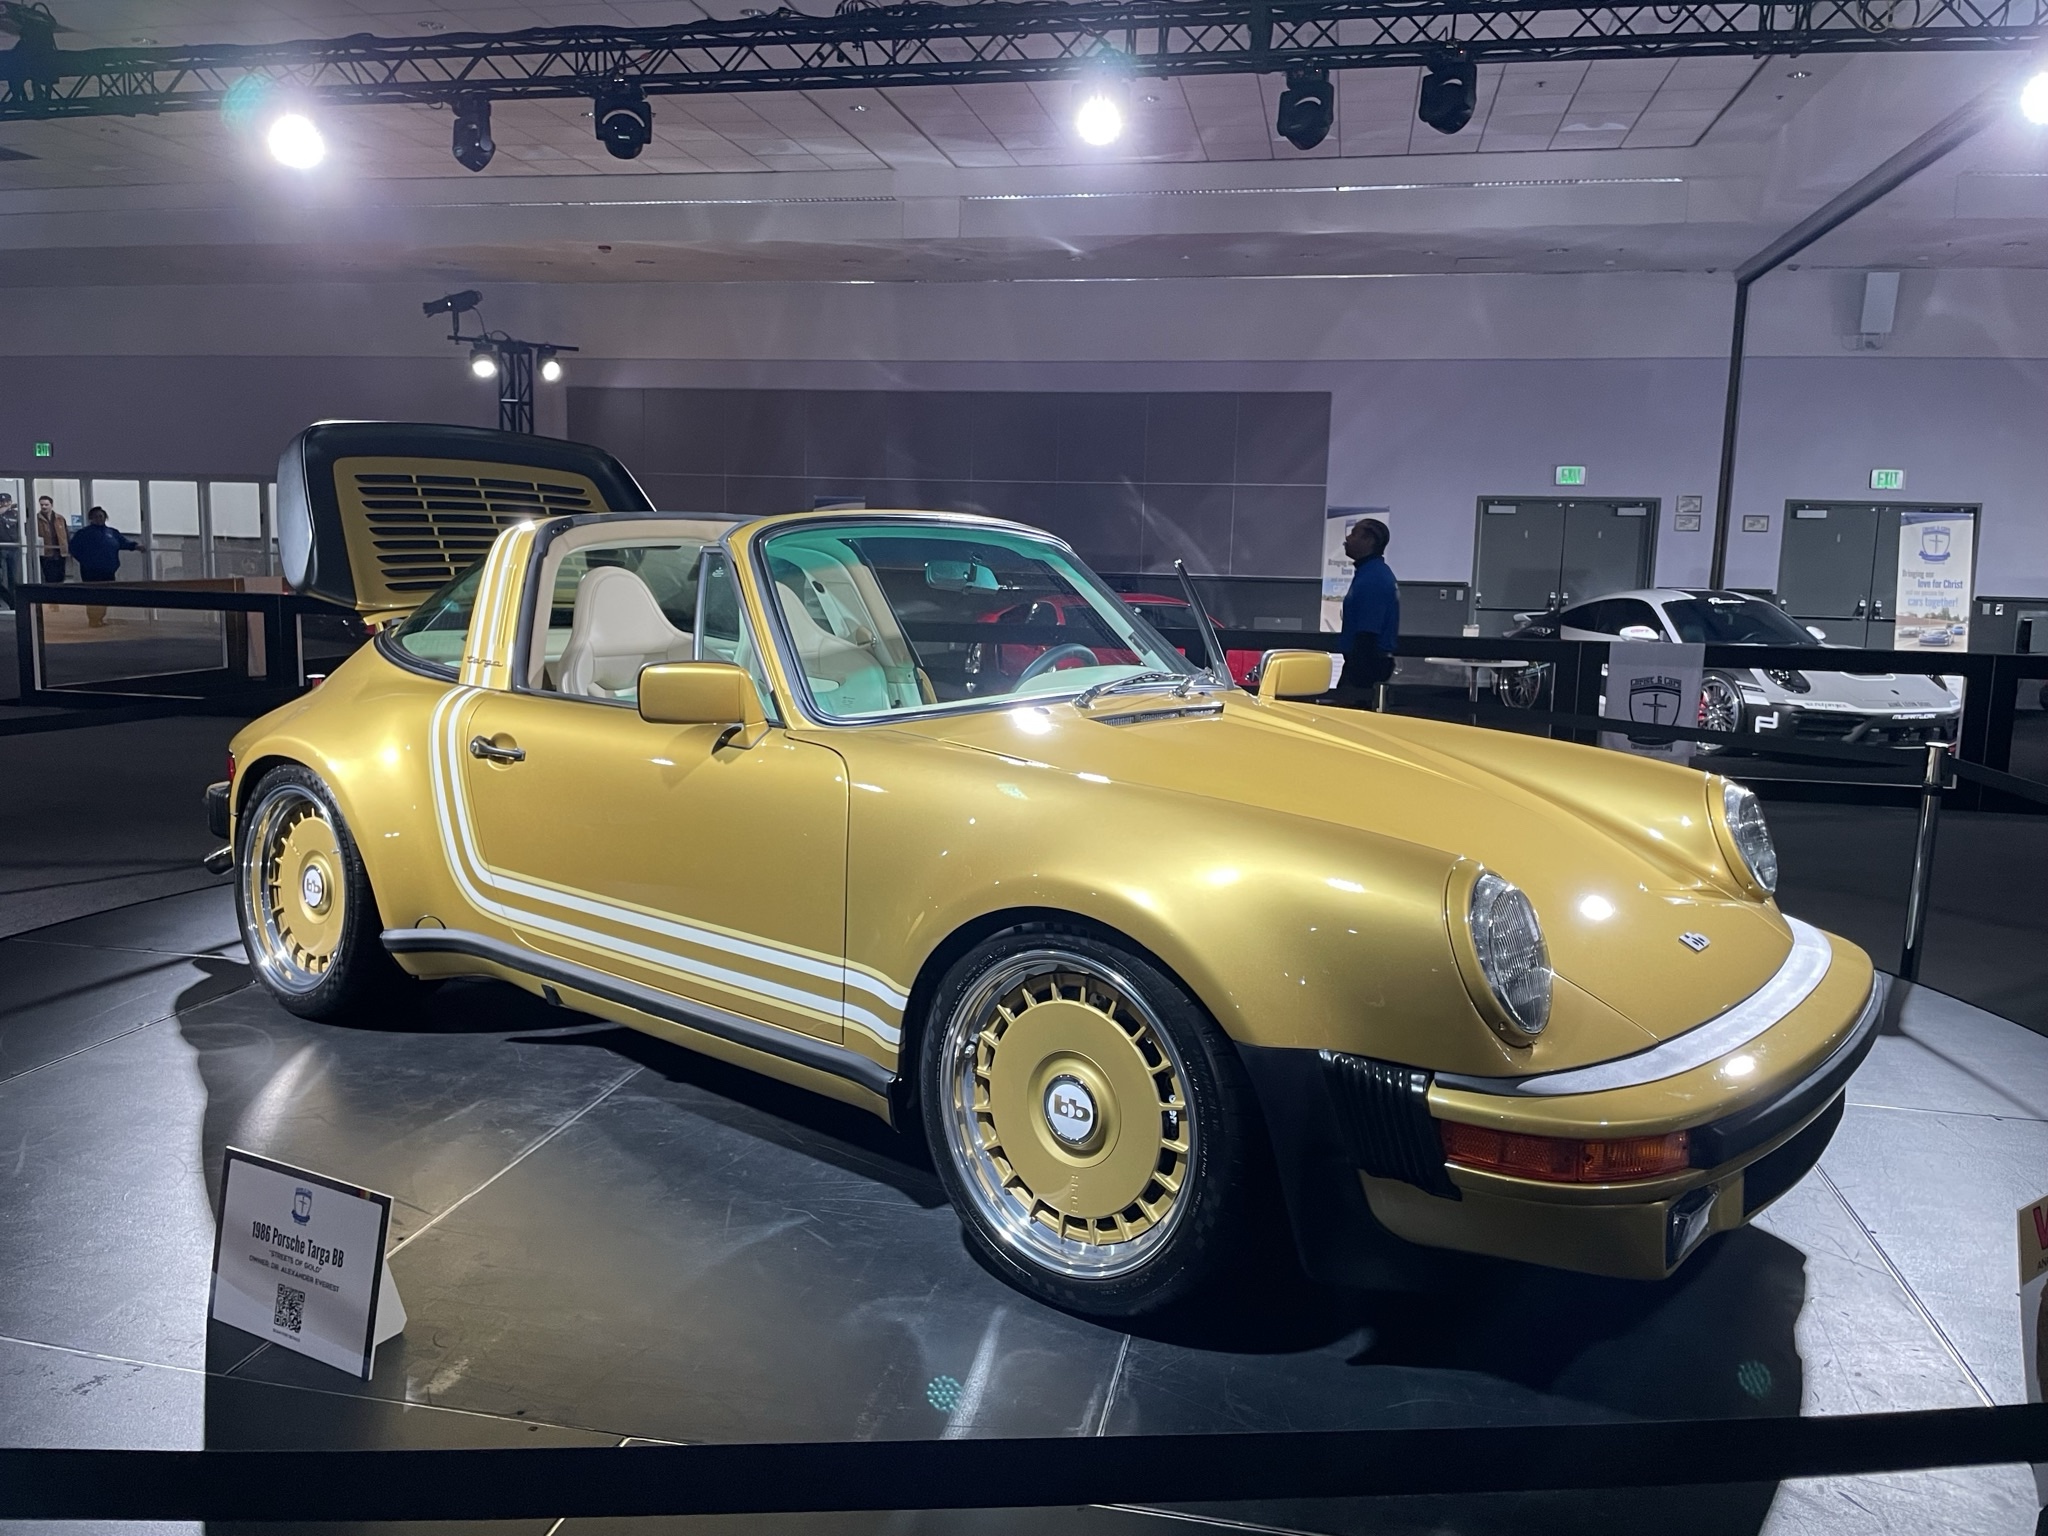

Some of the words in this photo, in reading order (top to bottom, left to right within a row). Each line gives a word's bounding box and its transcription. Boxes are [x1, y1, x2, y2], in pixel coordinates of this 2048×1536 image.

[1877, 471, 1899, 486] EXIT
[1932, 579, 1942, 588] for
[1943, 580, 1963, 589] Christ
[1054, 1093, 1090, 1122] bb
[252, 1221, 271, 1242] 1986
[272, 1227, 305, 1255] Porsche
[307, 1239, 330, 1266] Targa
[332, 1248, 344, 1268] BB
[281, 1267, 314, 1283] ALEXANDER
